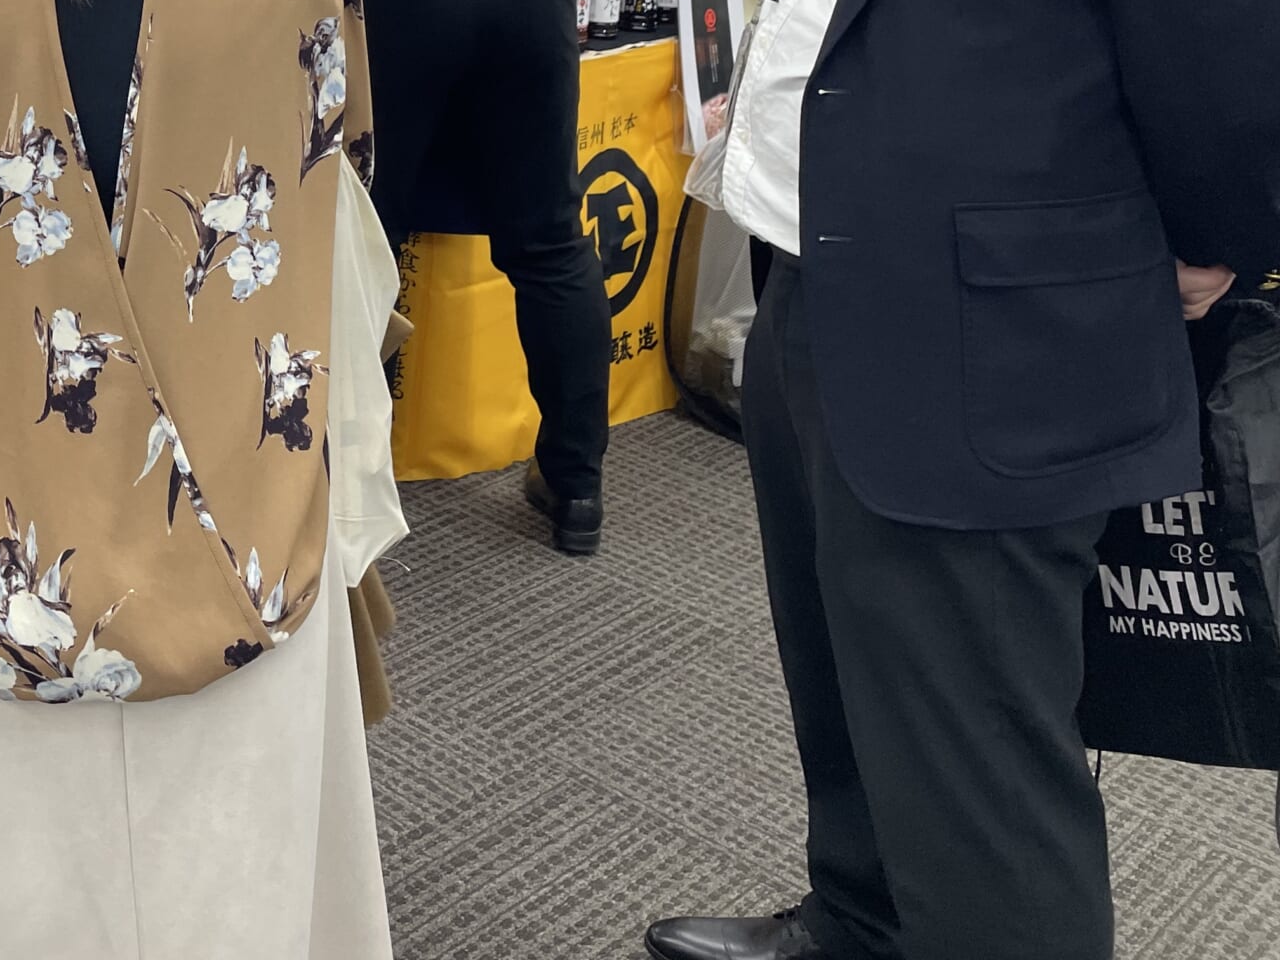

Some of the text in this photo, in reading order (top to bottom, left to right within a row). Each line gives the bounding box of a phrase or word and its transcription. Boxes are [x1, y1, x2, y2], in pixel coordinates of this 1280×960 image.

[610, 112, 639, 140] 松本
[1170, 542, 1217, 566] BE
[1109, 614, 1243, 643] MY HAPPINESS
